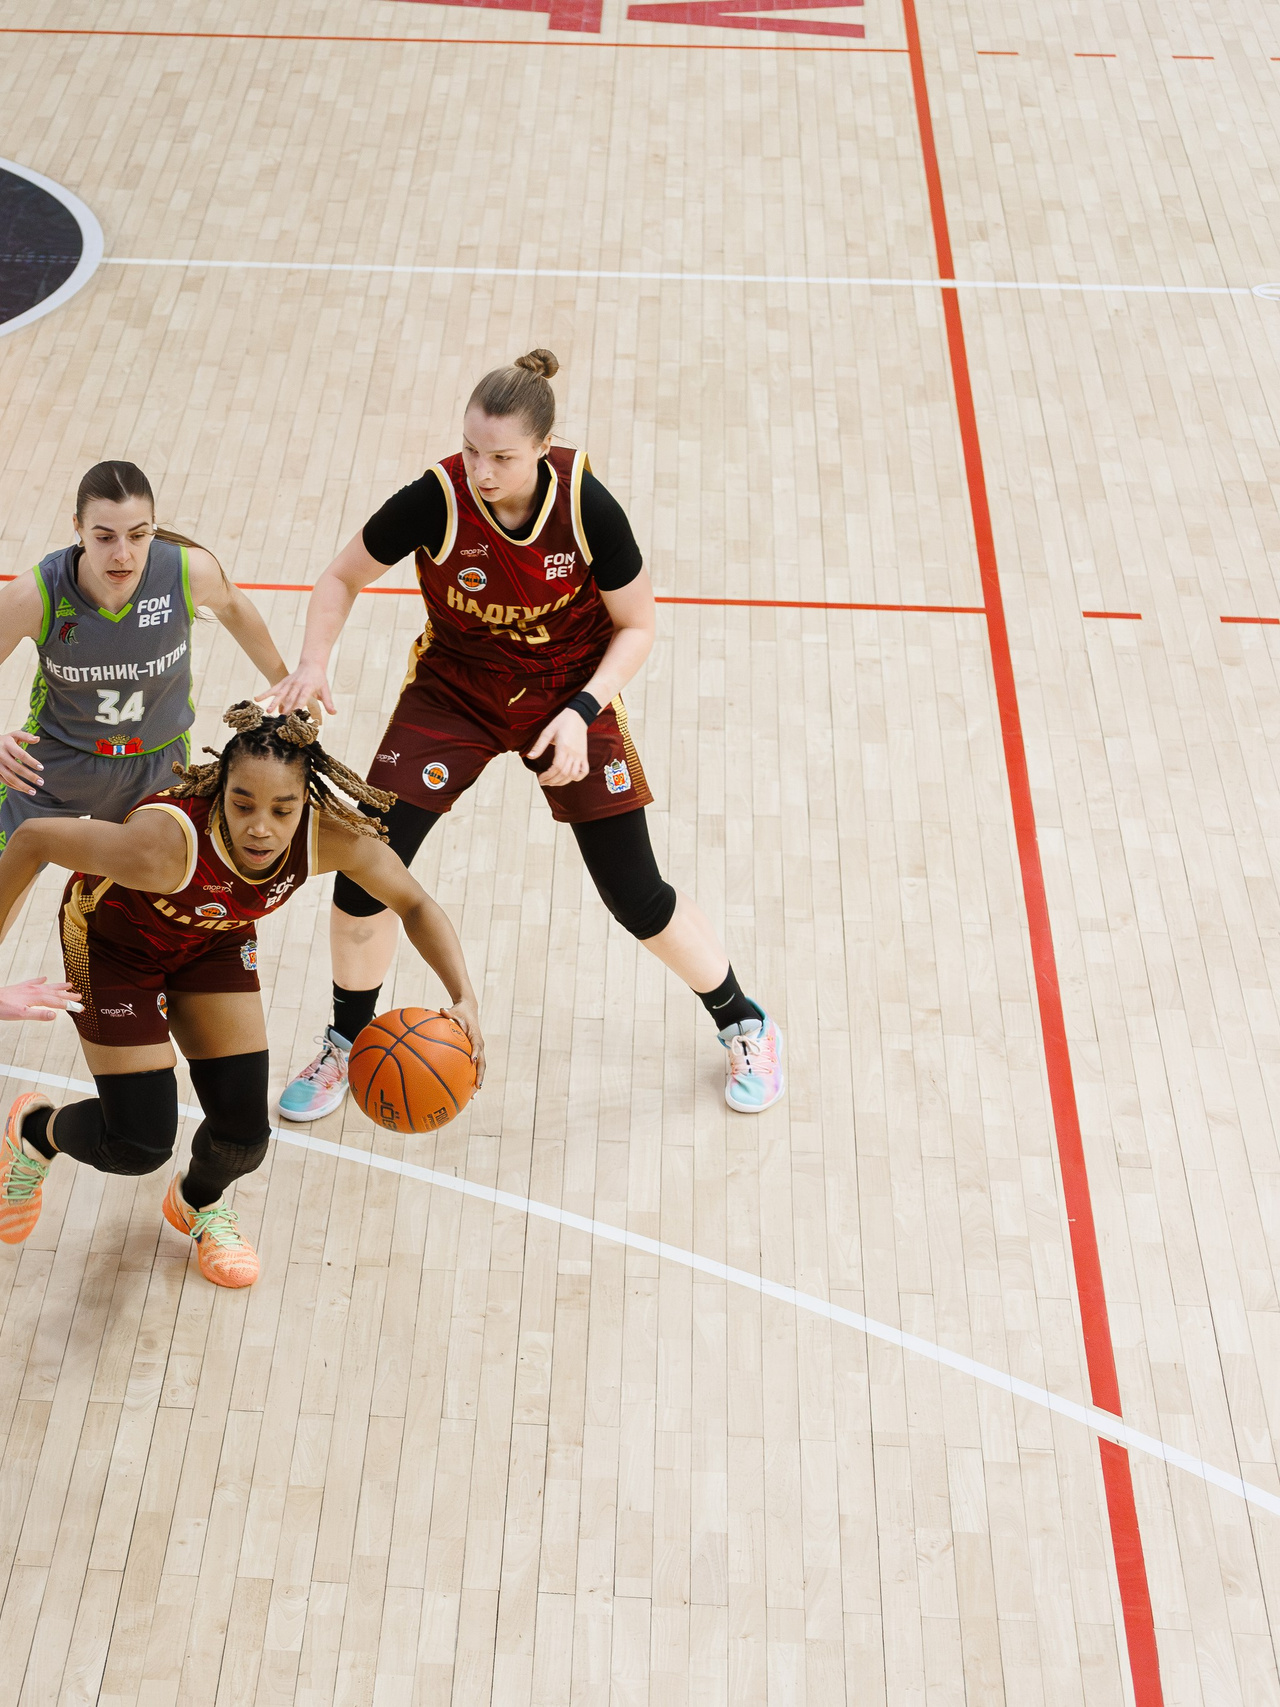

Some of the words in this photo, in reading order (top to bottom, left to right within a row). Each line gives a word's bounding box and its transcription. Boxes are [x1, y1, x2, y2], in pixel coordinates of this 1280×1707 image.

[543, 550, 576, 569] FON
[545, 560, 576, 581] BET
[136, 593, 171, 614] FON
[138, 608, 173, 628] BET
[94, 688, 146, 726] 34
